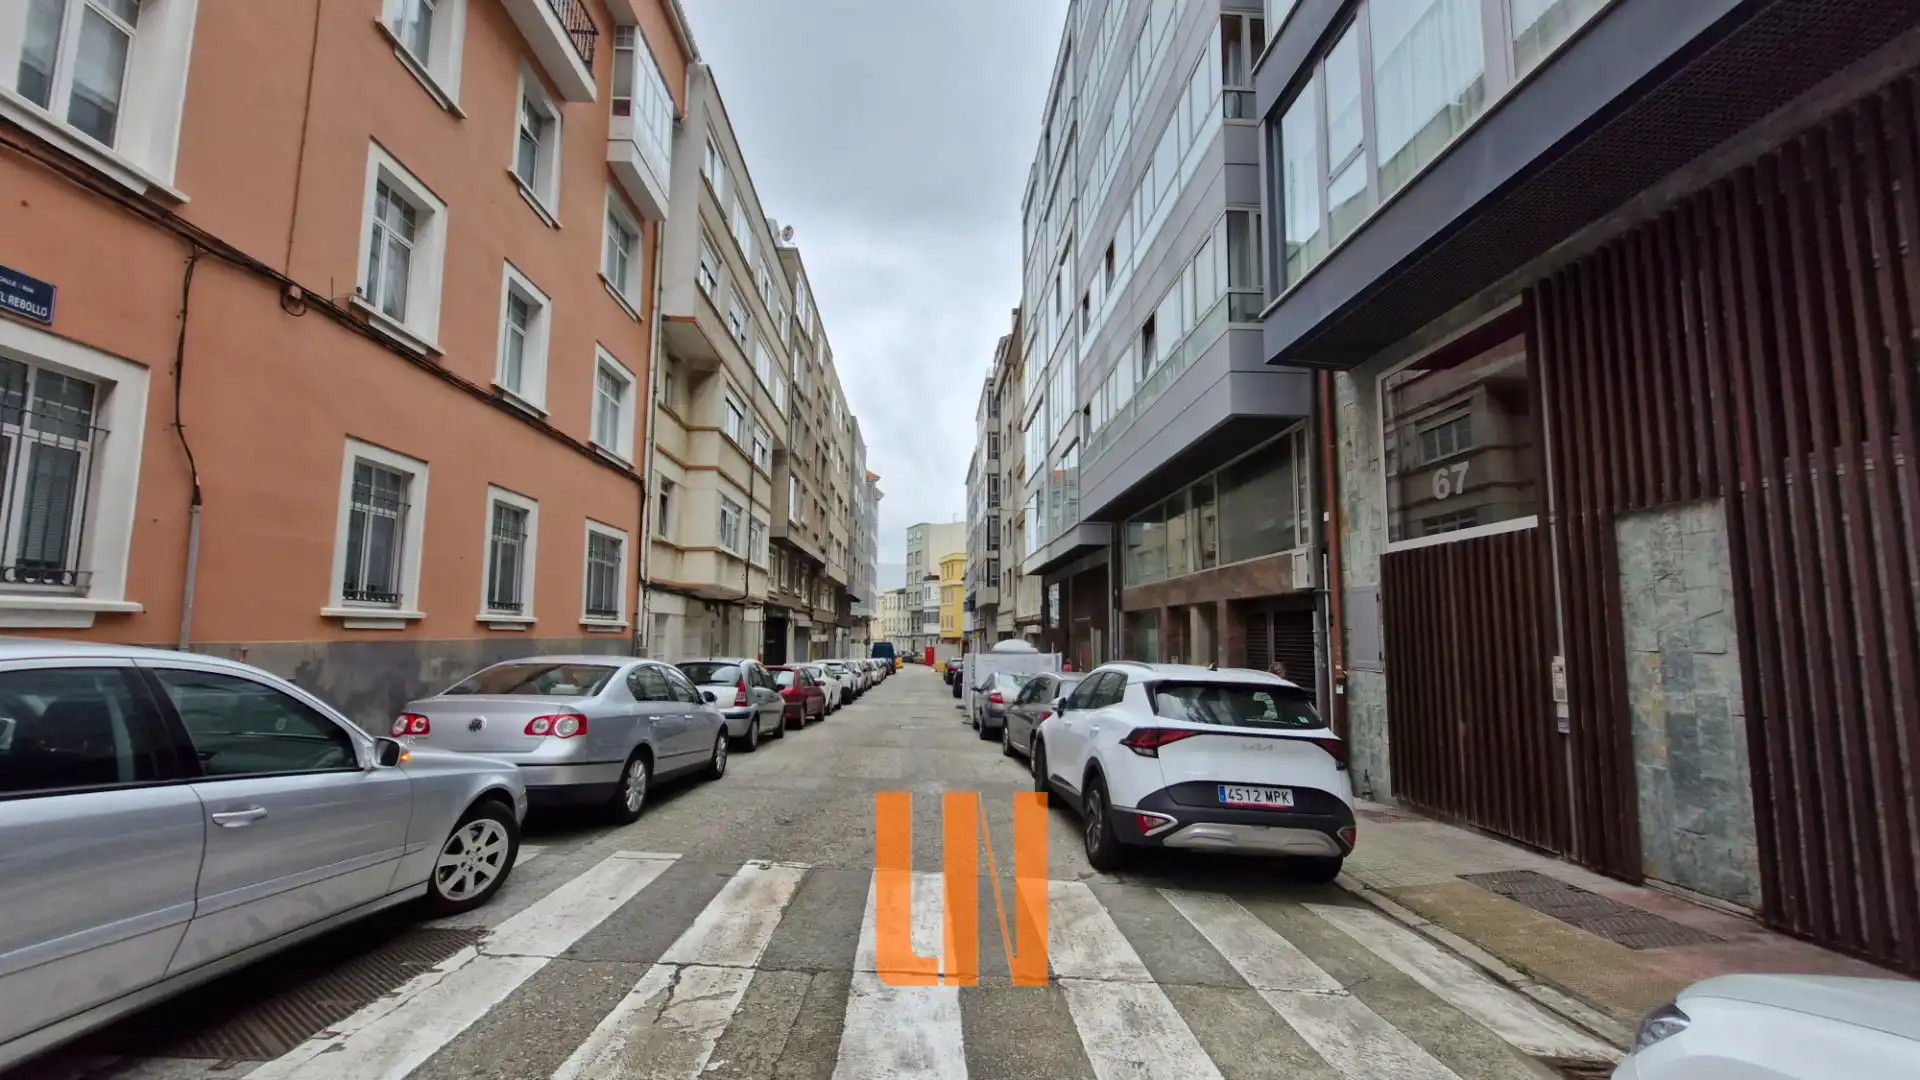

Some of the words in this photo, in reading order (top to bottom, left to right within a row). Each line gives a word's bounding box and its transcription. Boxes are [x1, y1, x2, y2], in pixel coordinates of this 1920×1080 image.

[8, 295, 48, 317] REBOLLO
[1433, 461, 1469, 500] 67
[1228, 788, 1261, 803] 4512
[1264, 790, 1291, 804] MPK
